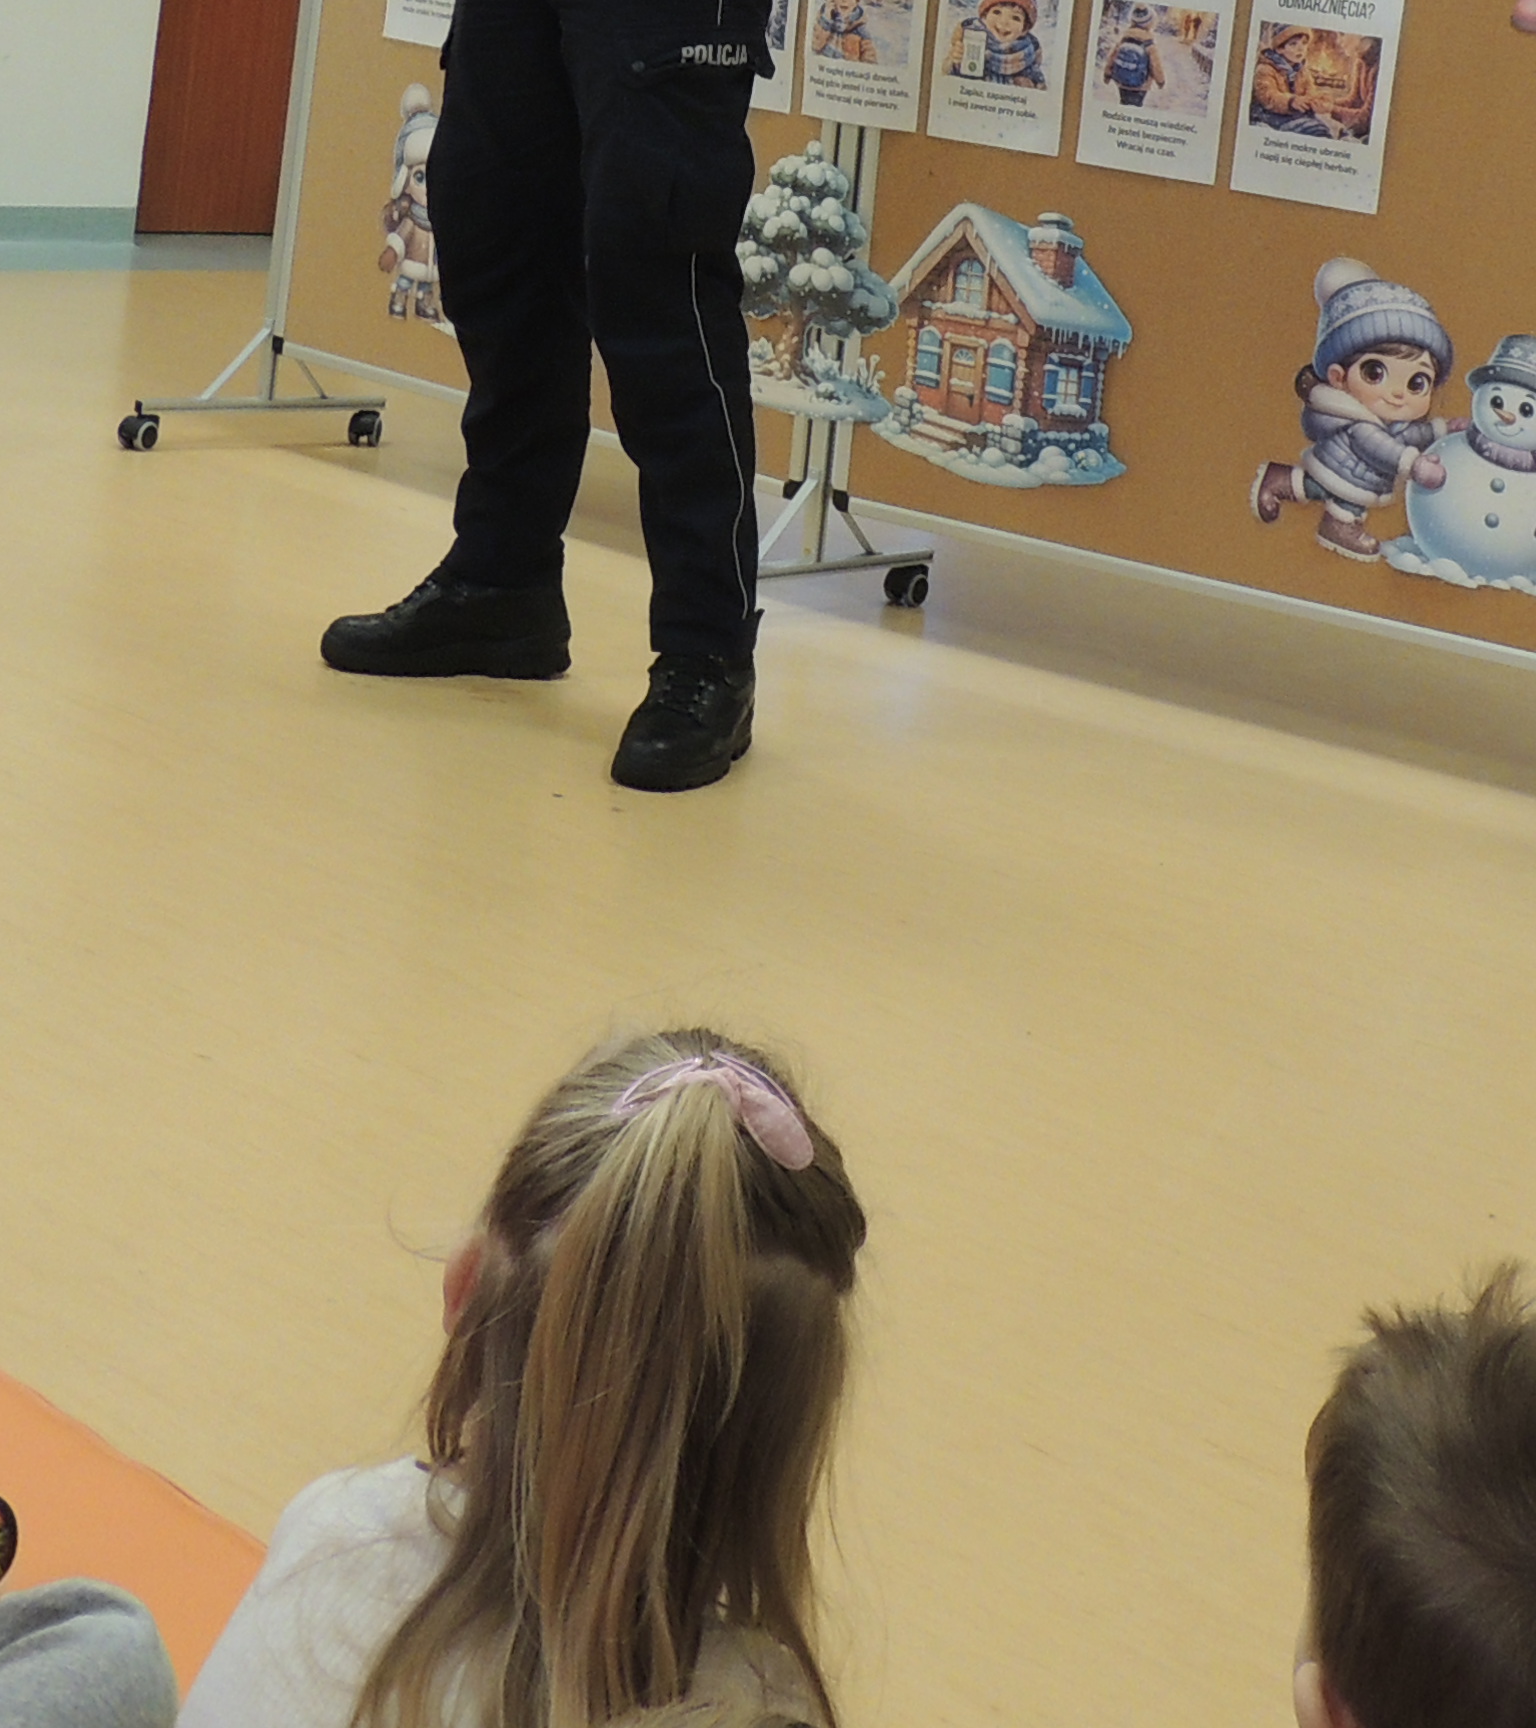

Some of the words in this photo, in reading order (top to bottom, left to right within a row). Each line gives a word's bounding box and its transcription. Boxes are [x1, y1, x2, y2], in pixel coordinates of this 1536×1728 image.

[680, 44, 748, 66] POLICJA
[998, 107, 1014, 117] przy
[1102, 110, 1132, 122] Rodzice
[1133, 117, 1158, 128] muszą
[1117, 127, 1140, 138] jesteś
[1116, 140, 1143, 154] Wracaj
[1145, 146, 1155, 154] na
[1263, 137, 1289, 149] Zmień
[1291, 143, 1317, 154] mokre
[1319, 148, 1351, 160] ubranie
[1260, 152, 1280, 163] napij
[1281, 156, 1292, 165] się
[1294, 158, 1322, 170] ciepłej
